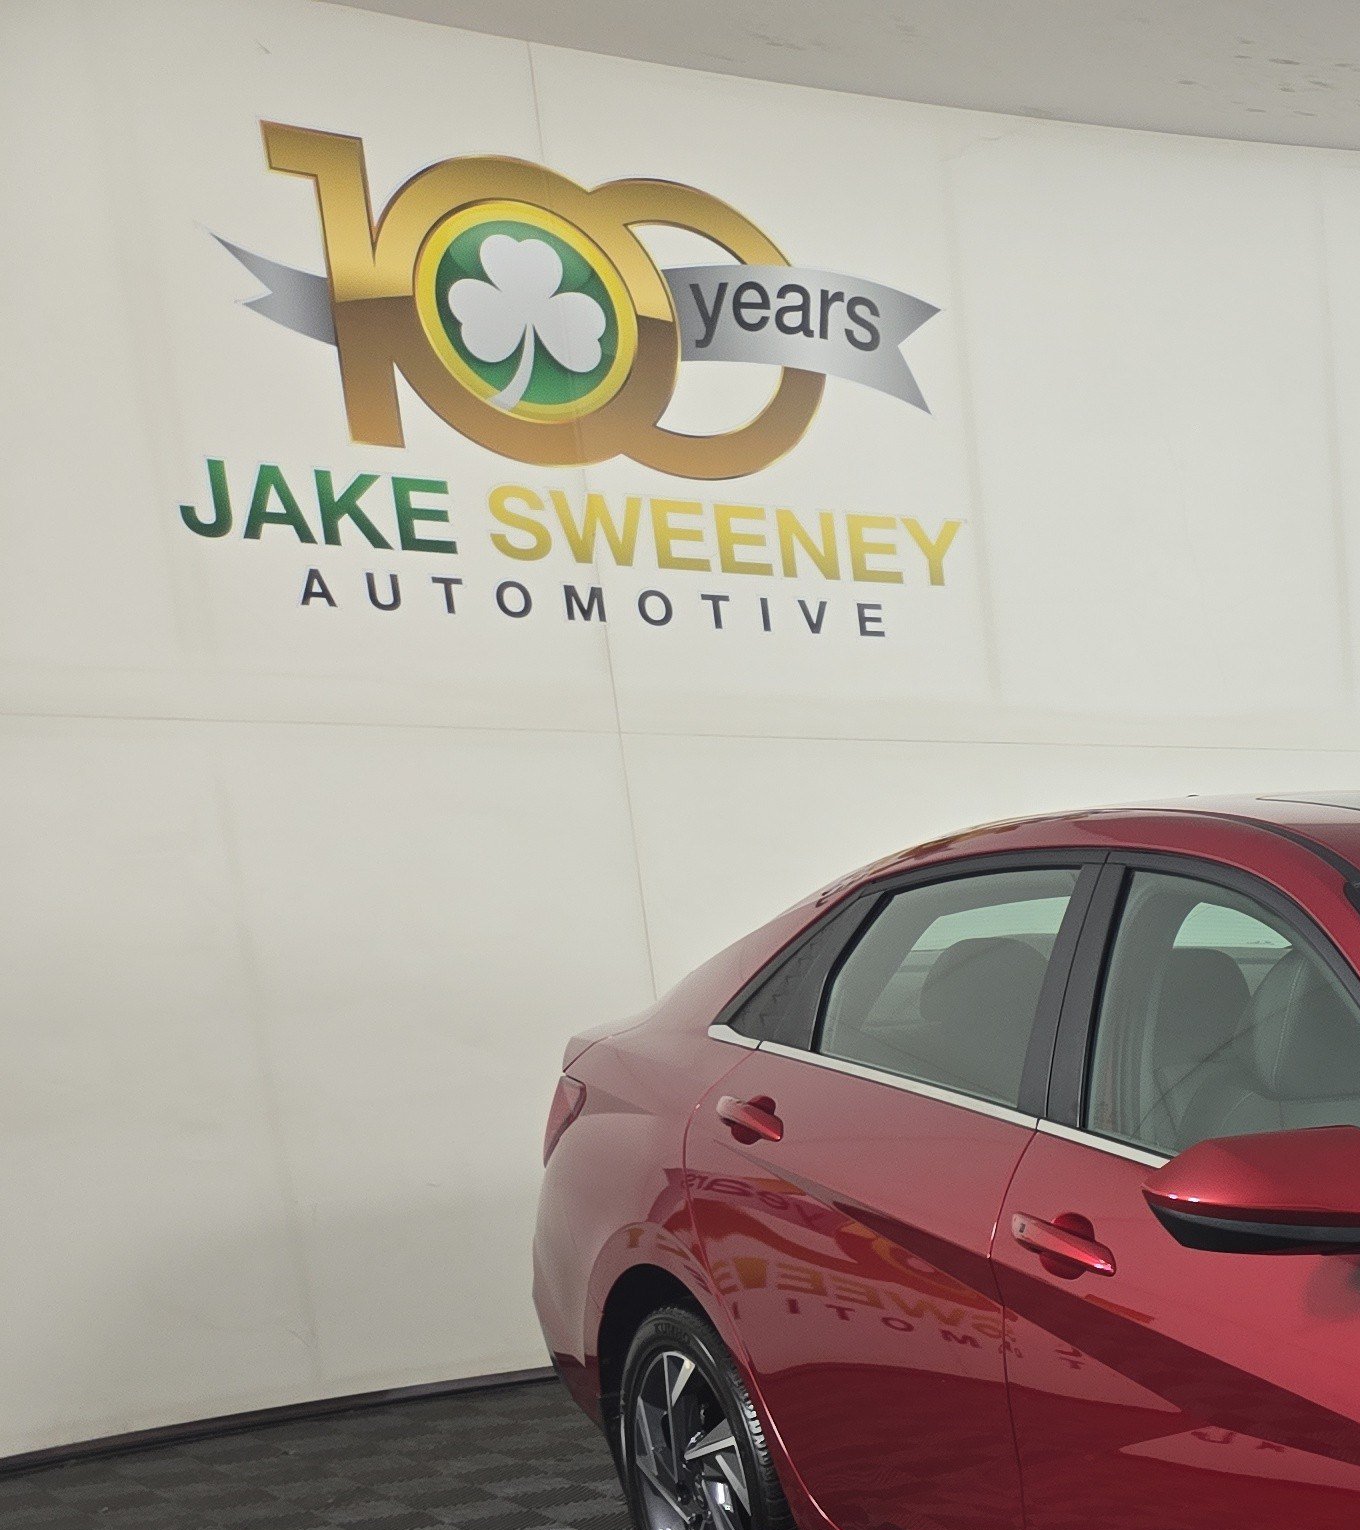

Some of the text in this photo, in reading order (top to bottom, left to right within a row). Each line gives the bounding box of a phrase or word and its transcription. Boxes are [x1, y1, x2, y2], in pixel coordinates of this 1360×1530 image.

[689, 273, 881, 353] years
[178, 458, 964, 586] JAKE SWEENEY
[300, 568, 886, 638] AUTOMOTIVE
